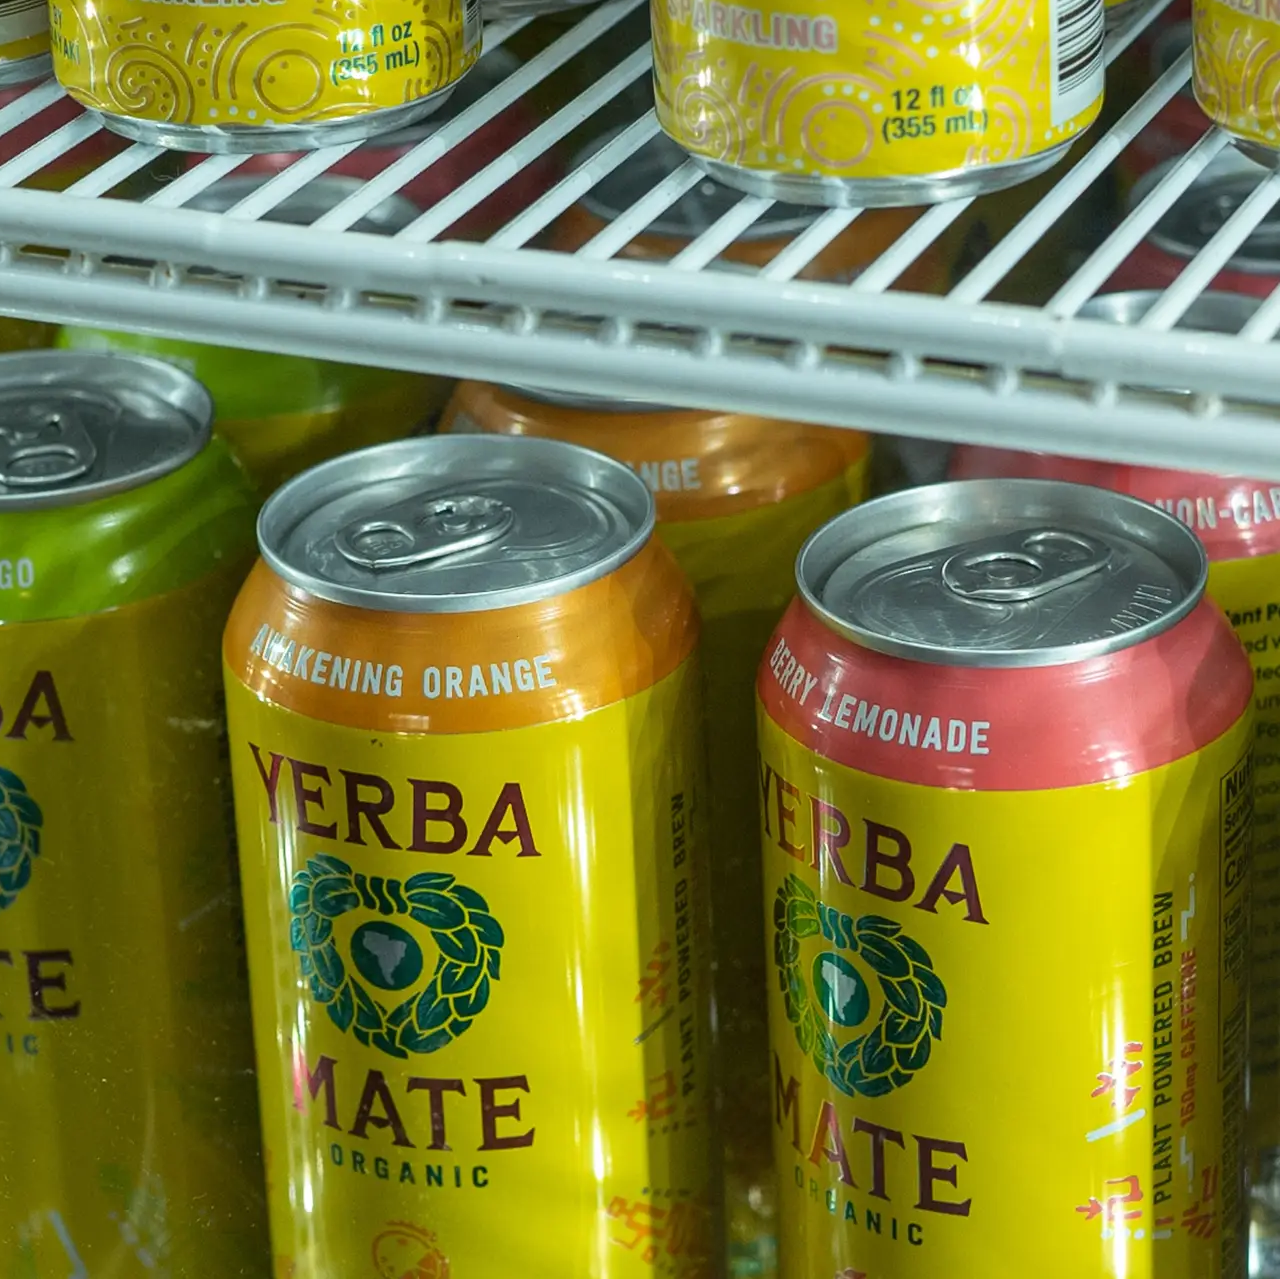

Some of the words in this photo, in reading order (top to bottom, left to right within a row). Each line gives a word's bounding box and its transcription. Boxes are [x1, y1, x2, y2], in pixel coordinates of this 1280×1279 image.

[385, 40, 422, 70] mL)
[390, 20, 414, 42] oz
[881, 116, 936, 145] (355
[945, 110, 989, 136] mL)
[891, 89, 922, 112] 12
[929, 85, 945, 108] fl
[250, 623, 405, 699] AWAKENING
[422, 653, 559, 701] ORANGE
[768, 636, 818, 708] BERRY
[821, 686, 992, 757] LEMONADE
[249, 741, 542, 859] YERBA
[671, 792, 686, 869] BREW
[759, 748, 991, 927] YERBA
[1153, 889, 1175, 970] BREW
[1152, 977, 1174, 1107] POWERED
[1180, 947, 1197, 1060] CAFFEINE
[287, 1035, 537, 1155] MATE
[771, 1049, 974, 1220] MATE
[329, 1141, 490, 1188] ORGANIC
[794, 1164, 925, 1249] ORGANIC
[1153, 1121, 1173, 1207] PLANT
